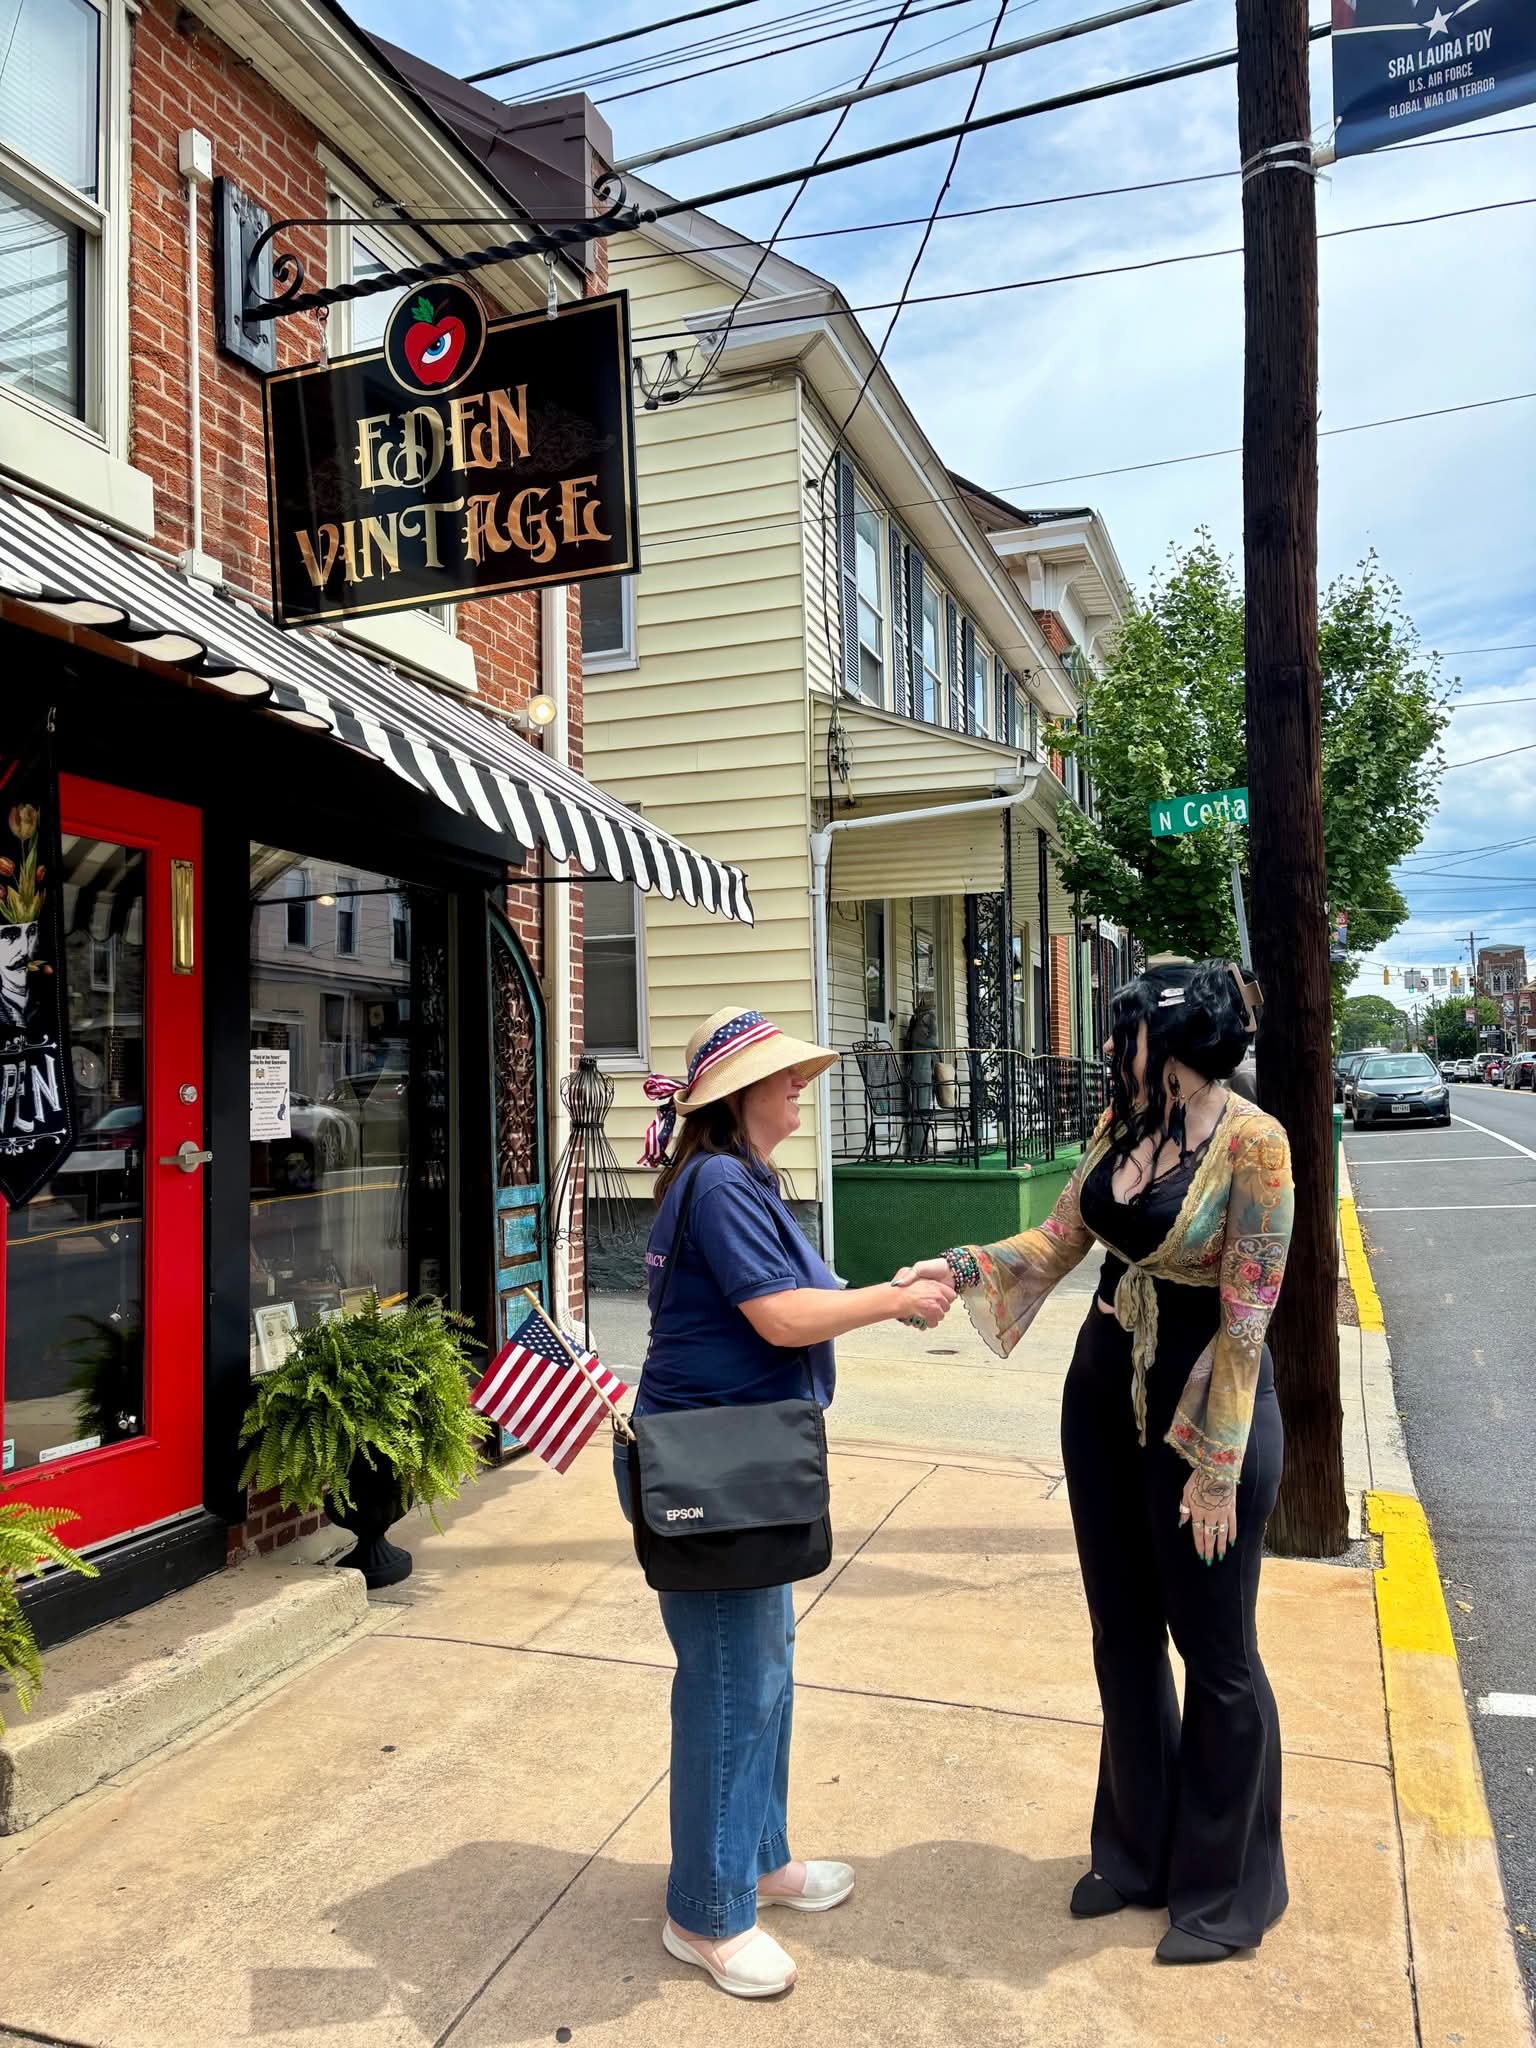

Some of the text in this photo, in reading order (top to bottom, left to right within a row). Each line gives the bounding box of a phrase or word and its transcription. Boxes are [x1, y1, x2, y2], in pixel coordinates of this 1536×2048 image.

[1388, 27, 1493, 79] SRA LAURA FOY
[1389, 77, 1495, 119] GLOBAL WAR ON TERROR
[1408, 62, 1474, 93] U.S. AIR FORCE
[354, 384, 532, 494] EDEN
[294, 474, 613, 592] VINTAGE
[1159, 811, 1172, 832] N
[666, 1506, 704, 1521] EPSON
